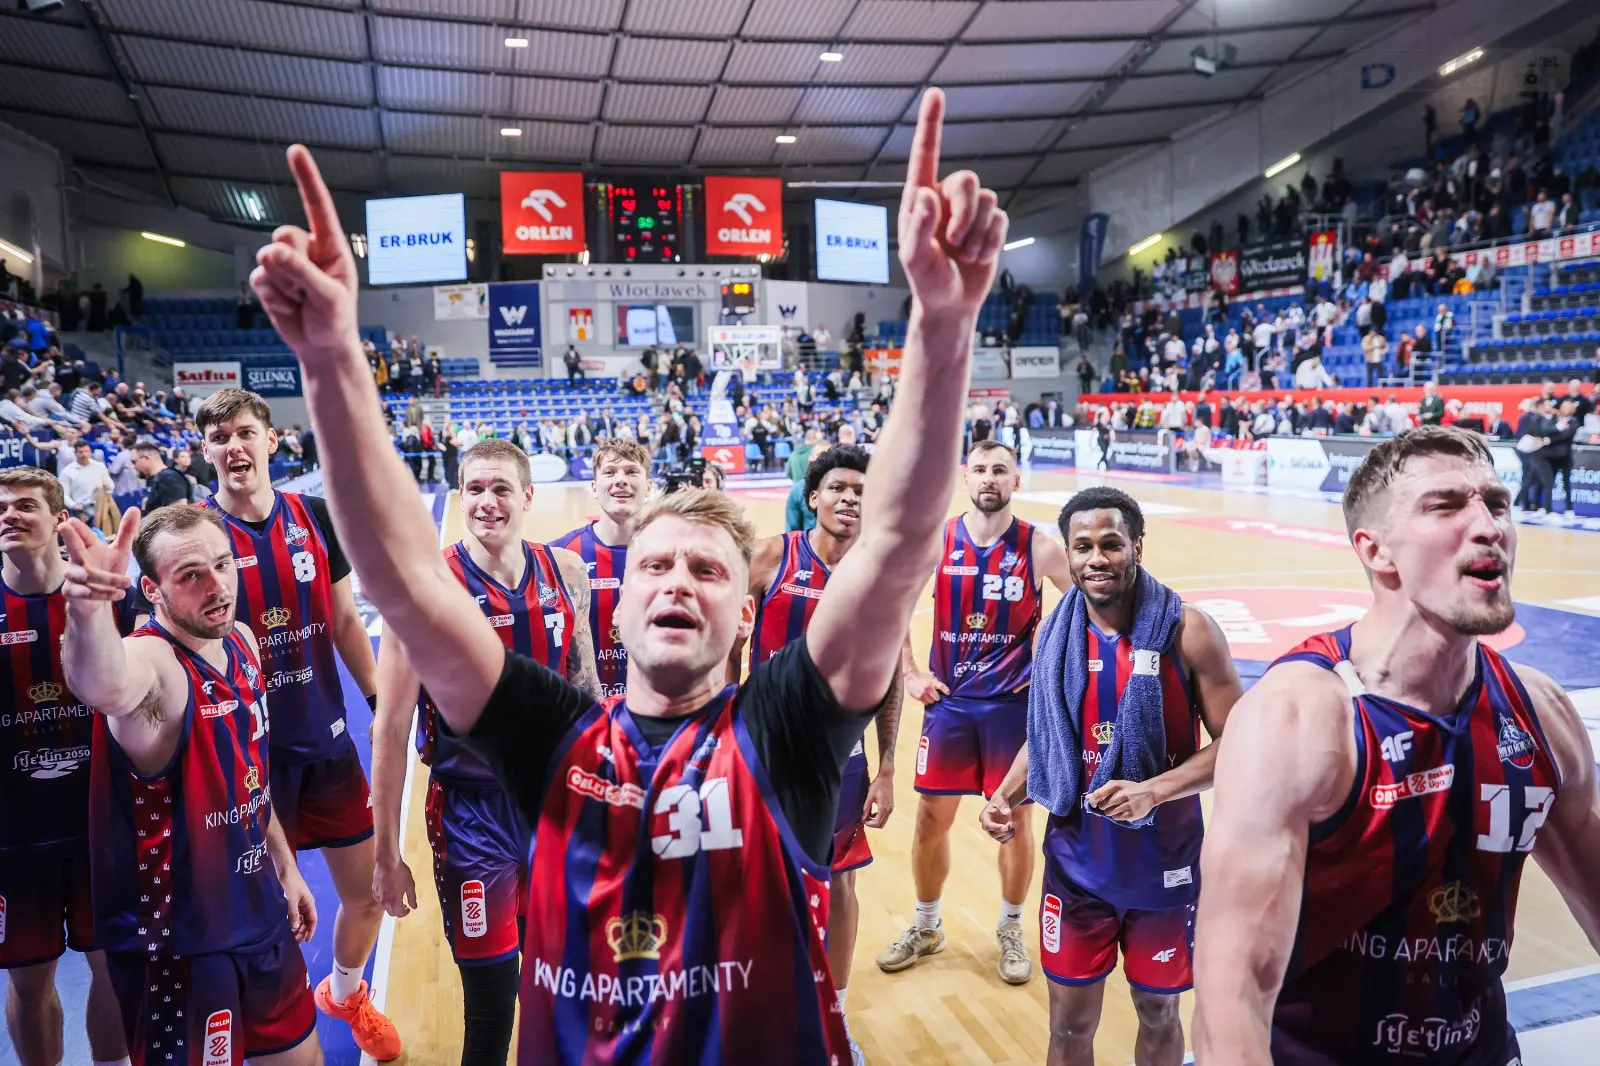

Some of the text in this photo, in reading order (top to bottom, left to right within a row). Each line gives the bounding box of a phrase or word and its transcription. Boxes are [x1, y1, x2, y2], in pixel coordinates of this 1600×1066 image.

[380, 231, 453, 248] ER-BRUK
[515, 226, 573, 241] ORLEN
[718, 228, 771, 244] ORLEN
[826, 234, 879, 250] ER-BRUK
[248, 370, 296, 385] SELENKA
[291, 551, 317, 583] 8
[982, 573, 1024, 602] 28
[544, 612, 565, 648] 7
[15, 704, 95, 725] APARTAMEN
[65, 749, 91, 760] 2050
[1380, 730, 1414, 763] 4F
[1428, 768, 1453, 780] Basket
[1428, 779, 1445, 789] Liga
[205, 806, 239, 830] KING
[651, 777, 744, 860] 31
[1475, 783, 1555, 853] 12
[1152, 947, 1176, 963] 4F
[580, 958, 753, 1006] APARTAMENTY
[209, 1017, 230, 1028] ORLEN
[206, 1058, 229, 1066] Basket
